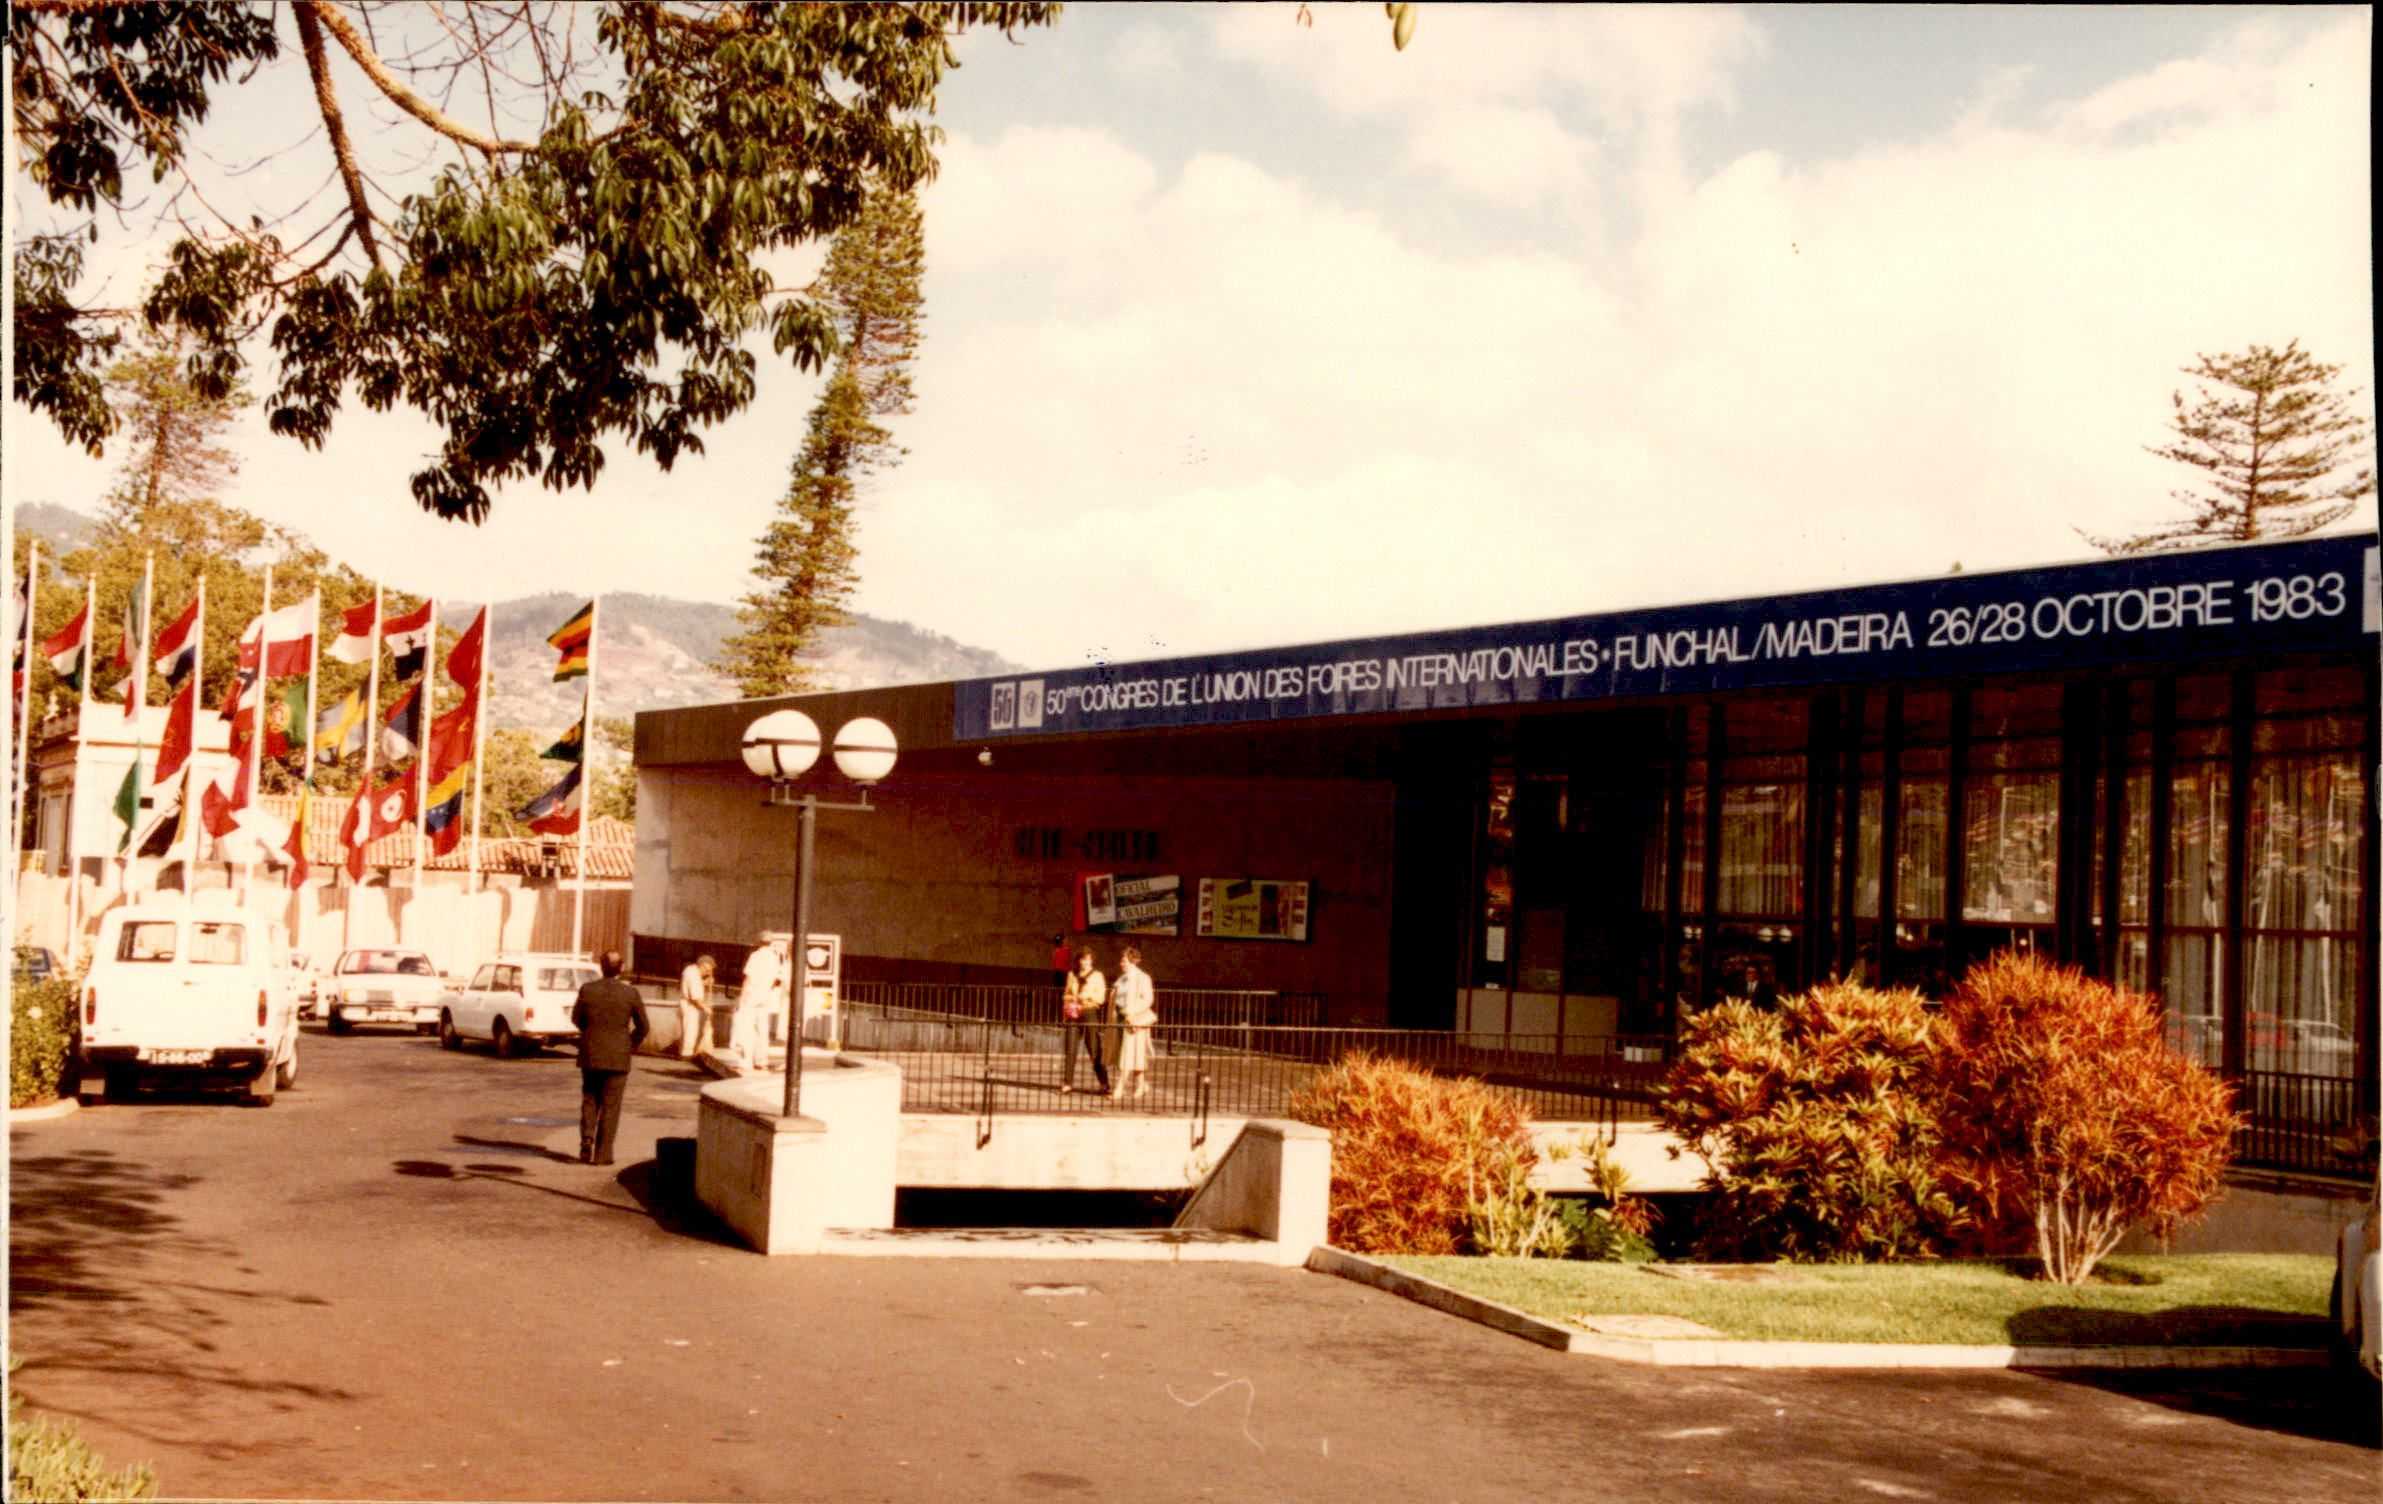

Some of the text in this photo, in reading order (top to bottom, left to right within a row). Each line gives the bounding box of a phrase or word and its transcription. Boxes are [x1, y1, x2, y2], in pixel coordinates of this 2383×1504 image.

[1162, 677, 1187, 707] DE
[1264, 666, 1304, 698] DES
[1306, 659, 1382, 695] FOIRES
[1386, 639, 1600, 690] INTERNATIONALES
[1927, 601, 2027, 647] 26/28
[2031, 580, 2236, 640] OCTOBRE
[2243, 571, 2347, 622] 1983
